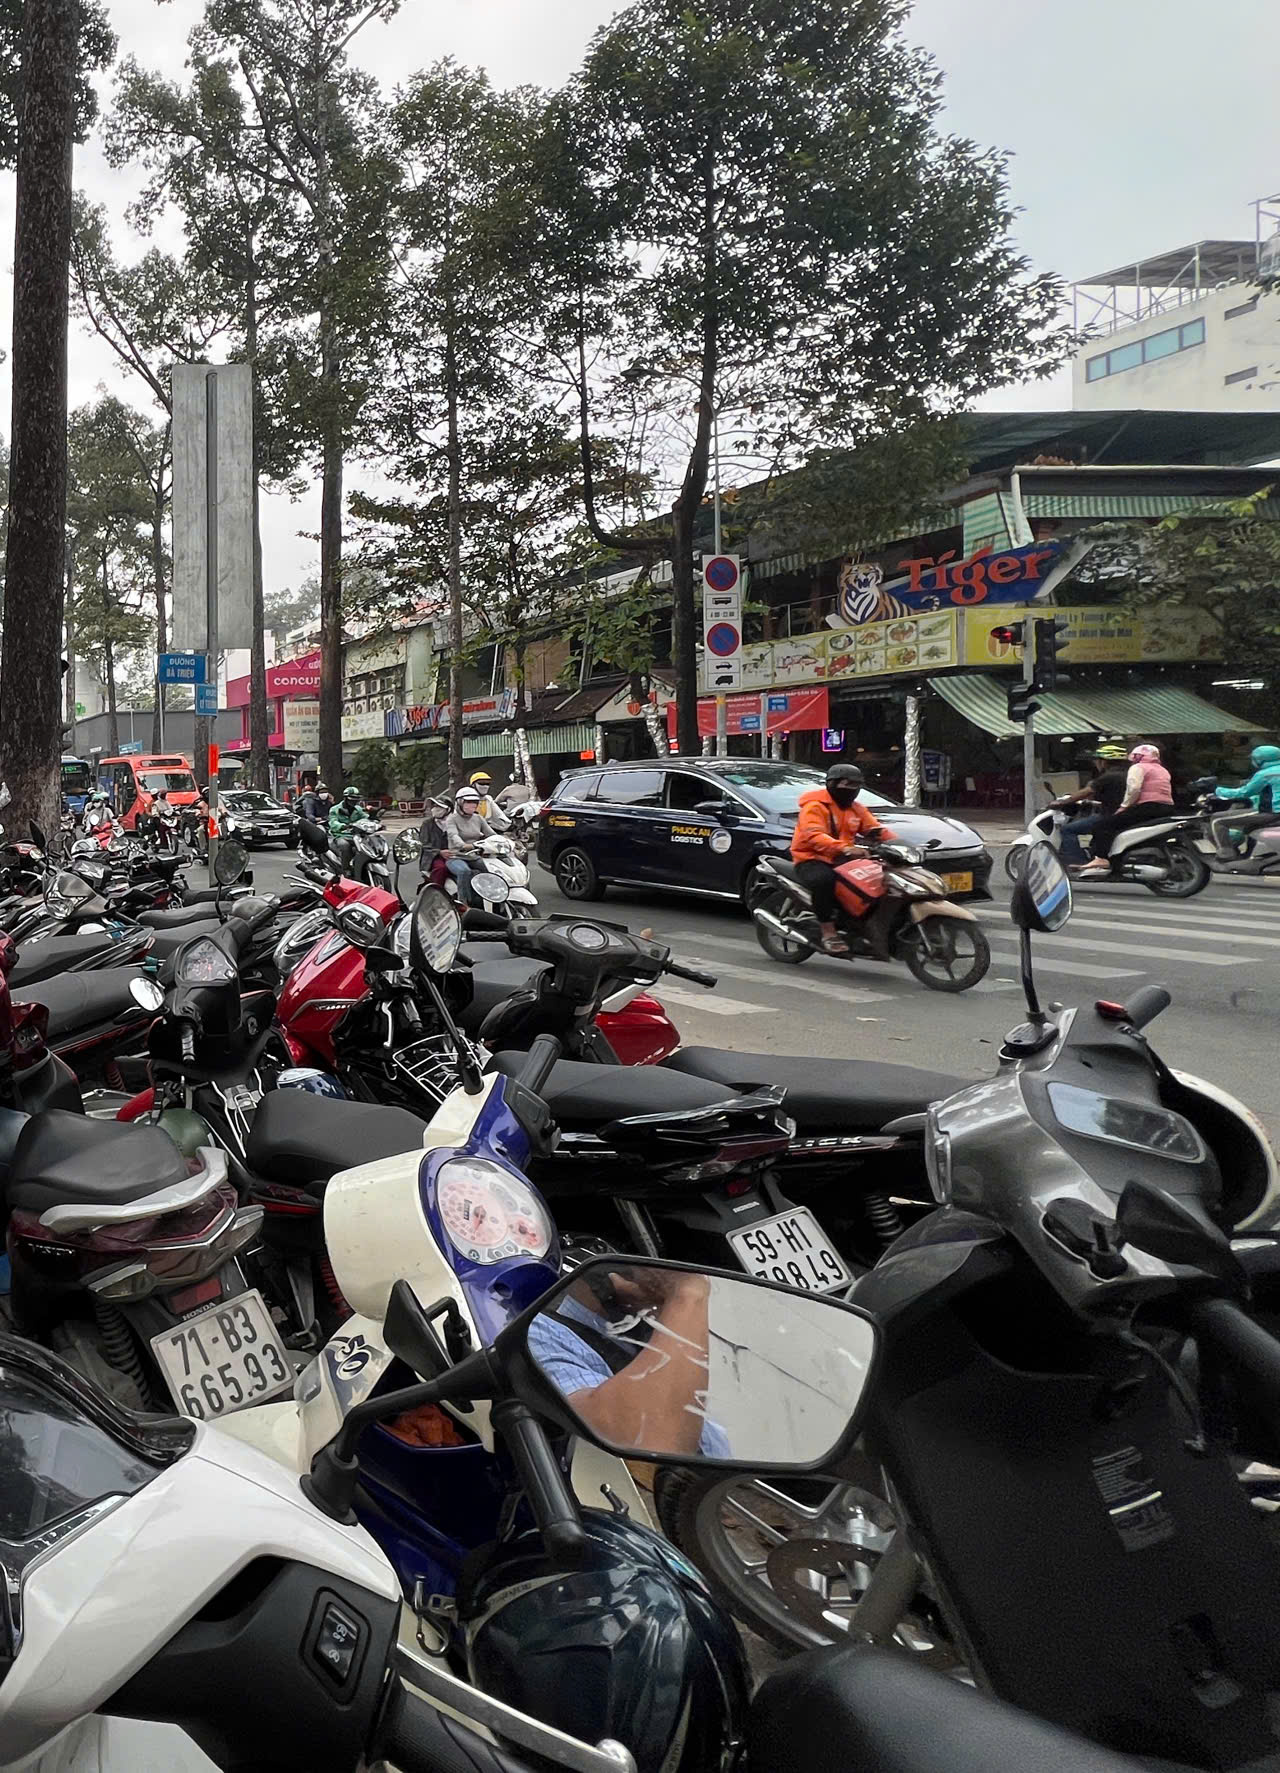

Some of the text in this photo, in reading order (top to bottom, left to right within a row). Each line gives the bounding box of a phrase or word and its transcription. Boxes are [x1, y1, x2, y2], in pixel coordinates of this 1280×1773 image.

[898, 545, 1053, 605] Tiger
[273, 676, 321, 686] concun
[670, 835, 704, 845] LOGISTICS
[742, 1218, 813, 1264] 59-H1
[182, 1302, 217, 1321] HONDA
[171, 1305, 258, 1376] 71-B3
[180, 1343, 287, 1420] 665.93
